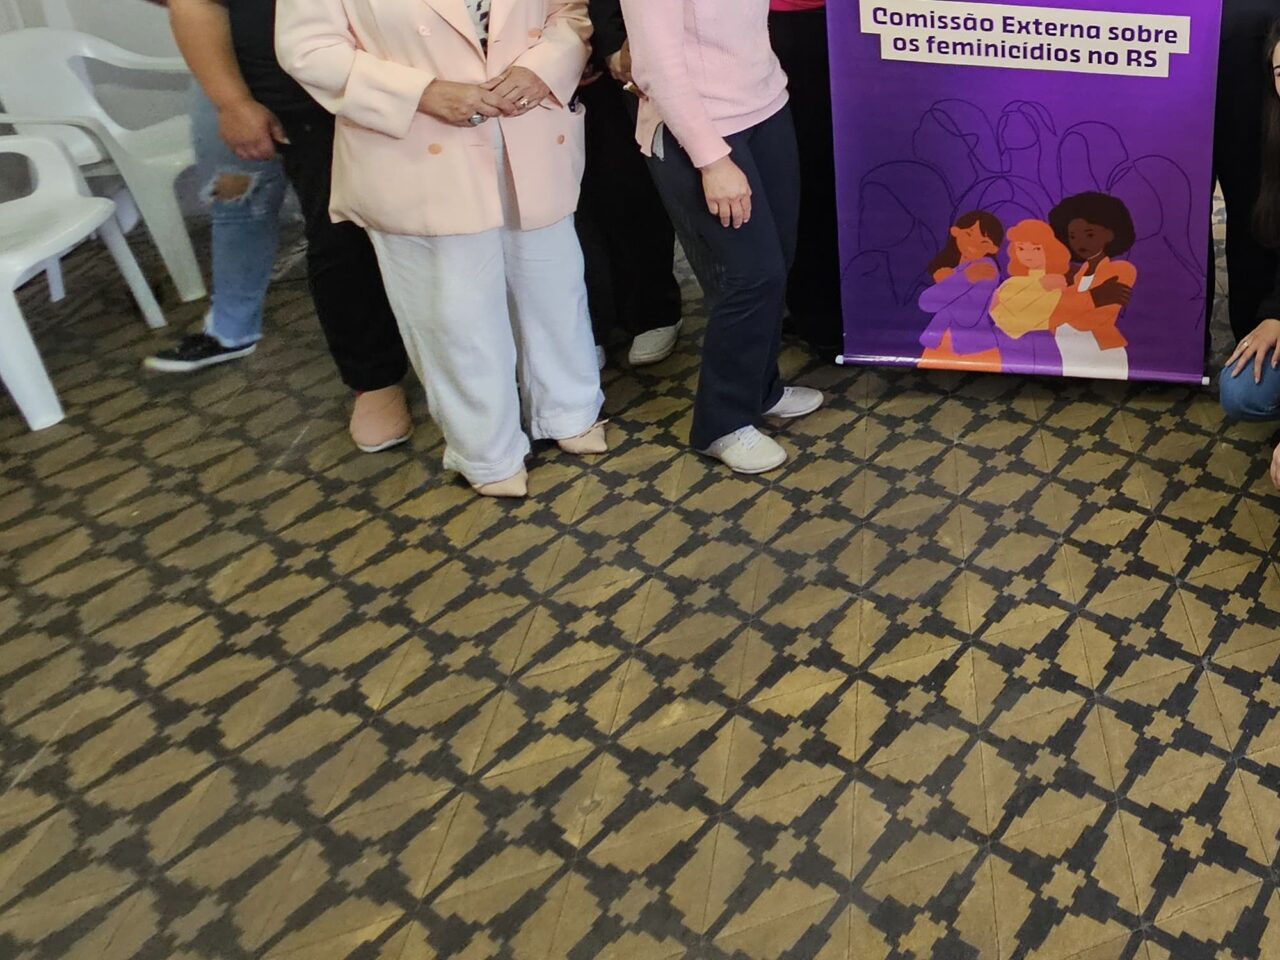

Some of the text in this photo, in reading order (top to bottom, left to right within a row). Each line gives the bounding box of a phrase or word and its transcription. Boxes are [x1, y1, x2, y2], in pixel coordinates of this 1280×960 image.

[872, 6, 1178, 44] Comissão Externa sobre
[893, 35, 1157, 68] os feminicídios no RS
